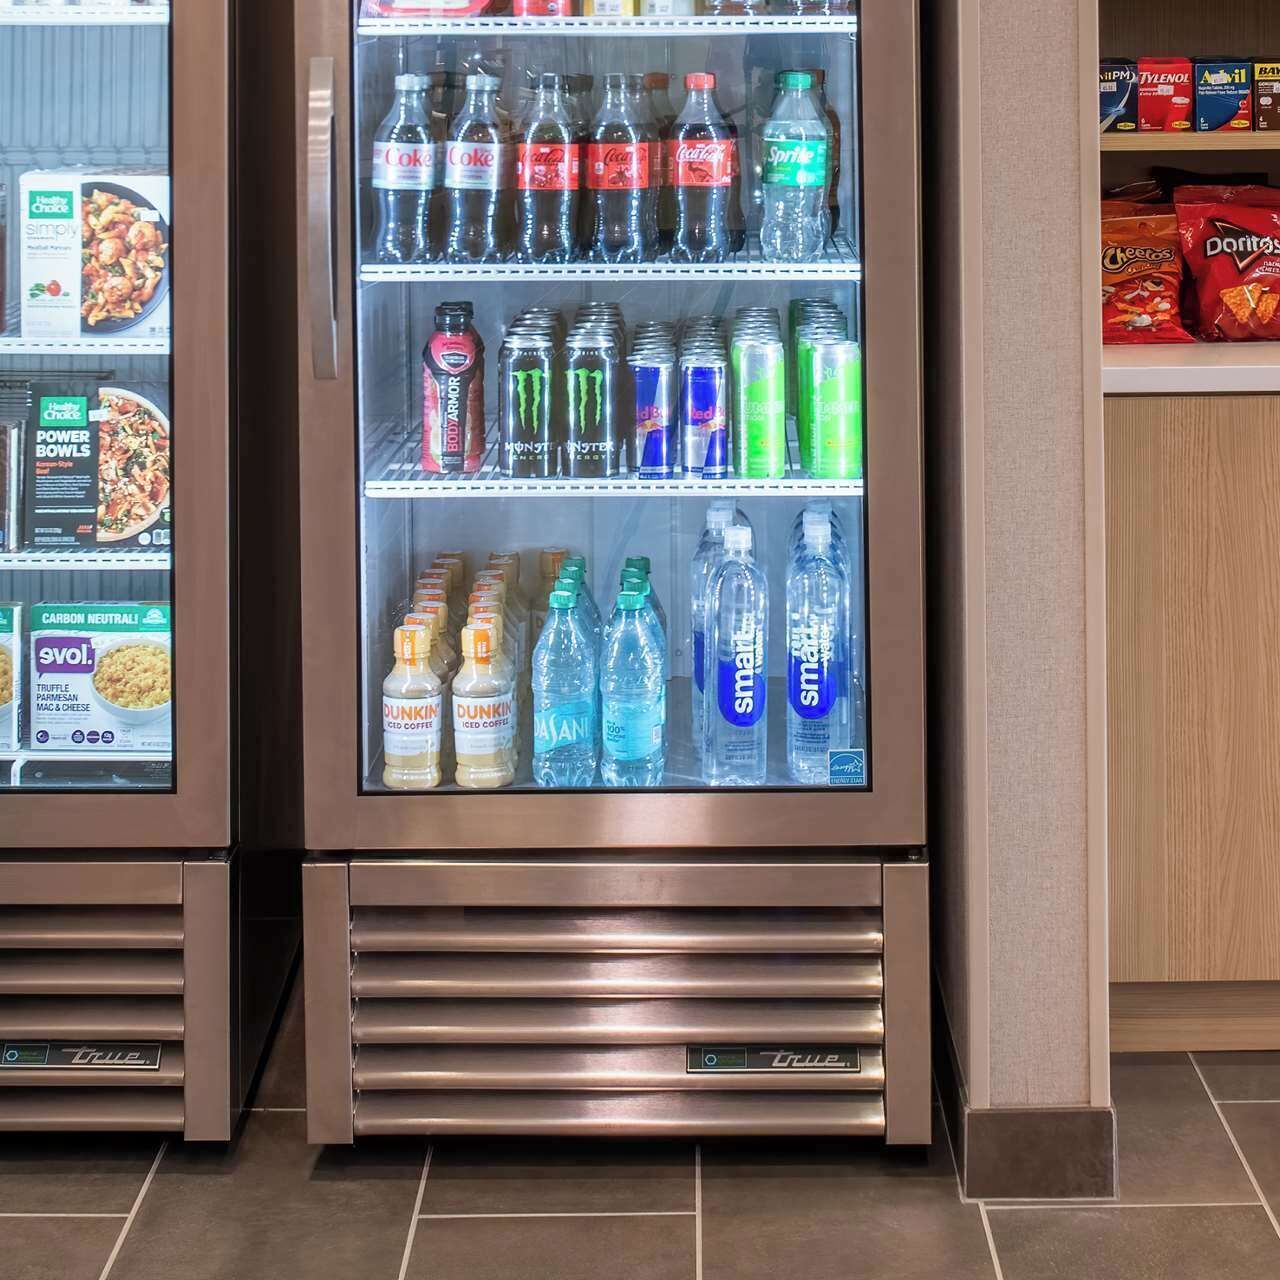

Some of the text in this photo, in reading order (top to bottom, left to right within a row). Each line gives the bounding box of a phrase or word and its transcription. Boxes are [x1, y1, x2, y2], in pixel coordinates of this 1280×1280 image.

[1139, 72, 1190, 84] TYLENOL
[384, 147, 433, 168] Coke
[448, 147, 495, 168] Coke
[36, 195, 68, 205] Healthy
[31, 203, 69, 213] Choice
[26, 223, 78, 240] simply
[1102, 247, 1172, 270] Cheetos
[48, 402, 80, 413] Healthy
[43, 410, 82, 420] Choice
[447, 376, 461, 453] BODYARMOR
[36, 430, 90, 443] POWER
[35, 444, 91, 458] BOWLS
[566, 441, 615, 452] ONSTER
[42, 613, 138, 624] CARBON NEUTRAL!
[36, 684, 69, 692] TRUFFLE
[36, 694, 78, 702] PARMESAN
[36, 704, 90, 712] MAC & CHEESE
[387, 720, 433, 730] ICED COFFEE
[462, 719, 510, 729] ICED COFFEE
[534, 715, 590, 746] DASANI
